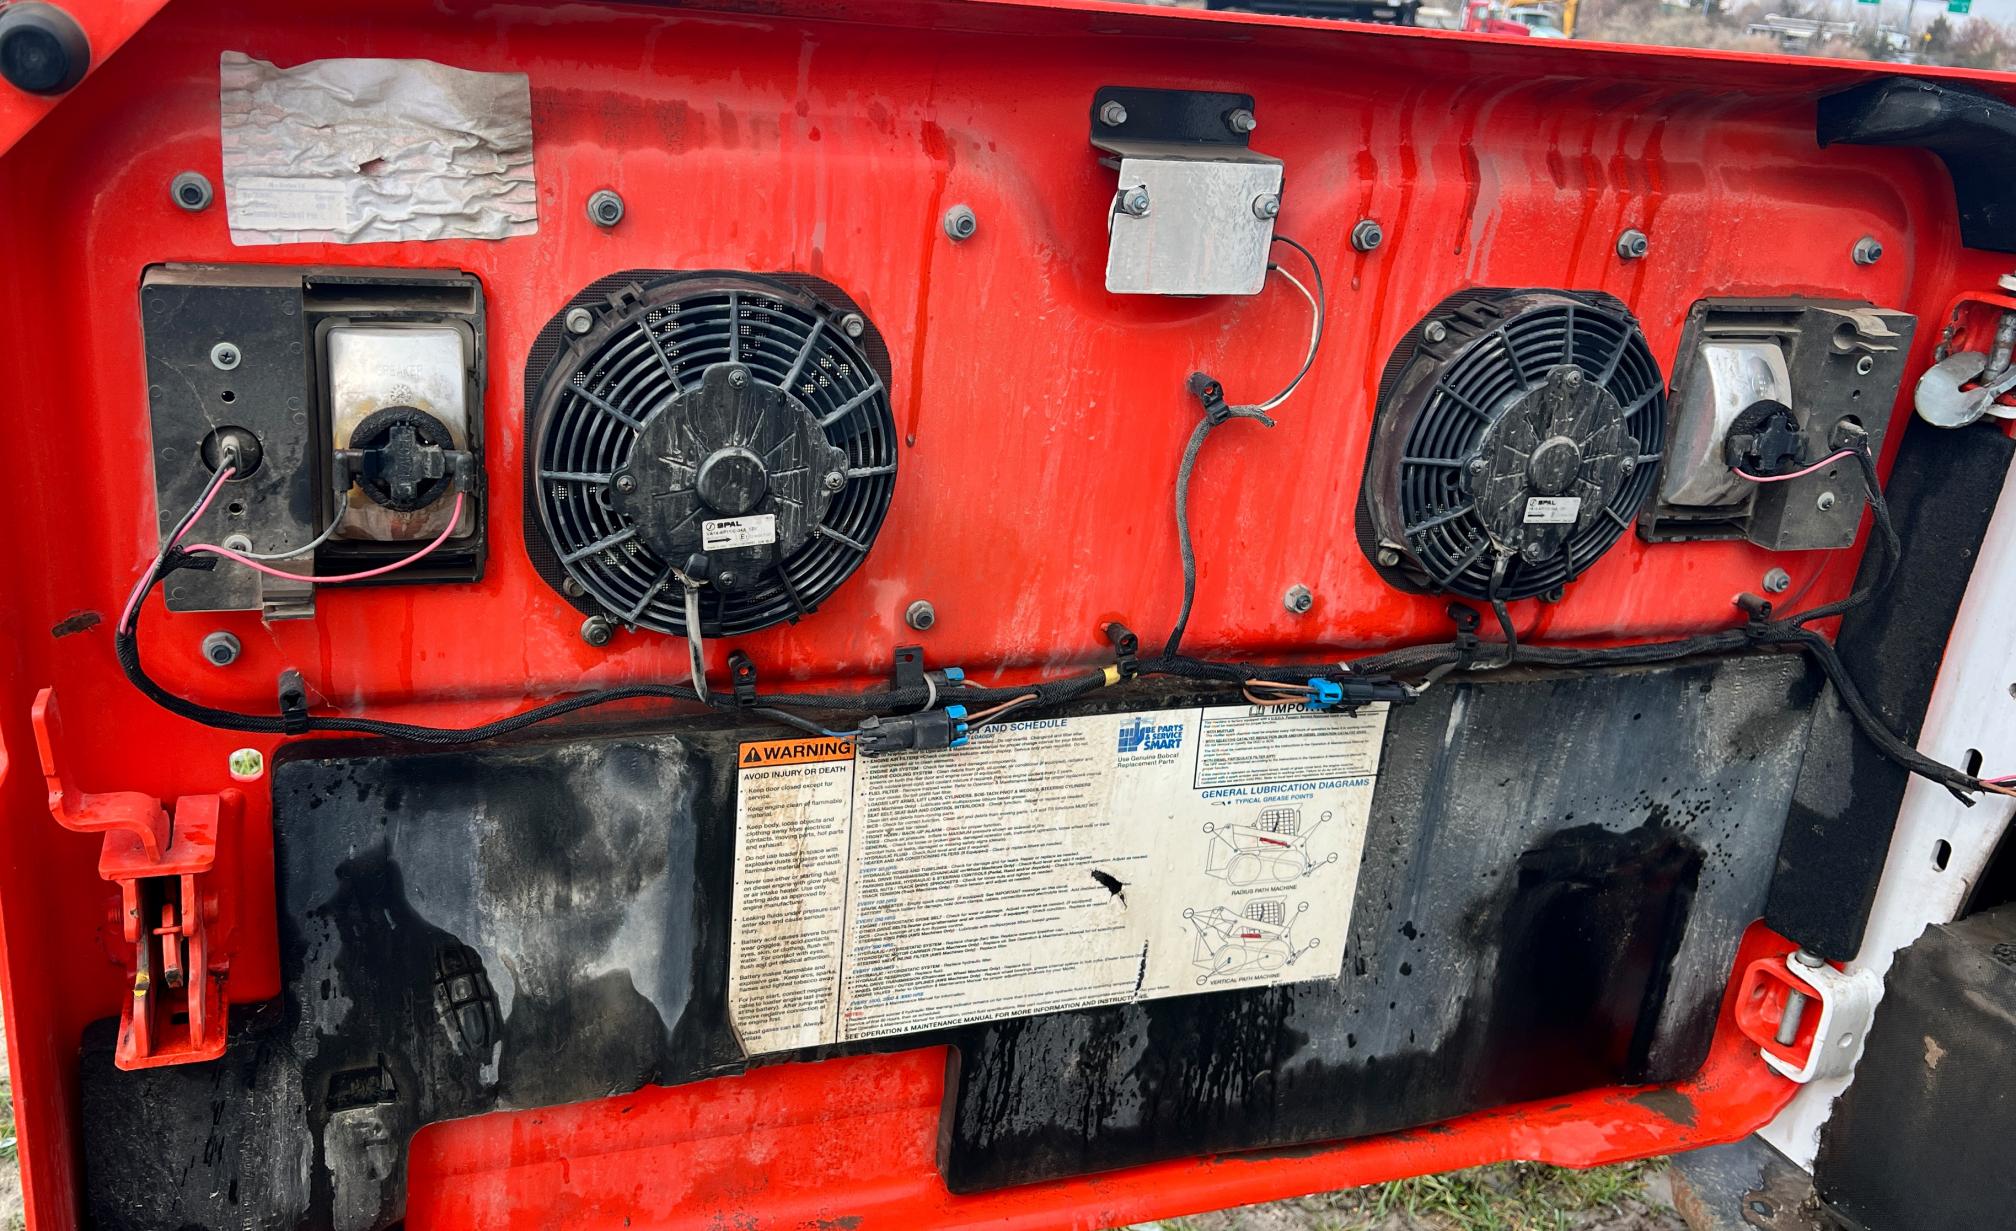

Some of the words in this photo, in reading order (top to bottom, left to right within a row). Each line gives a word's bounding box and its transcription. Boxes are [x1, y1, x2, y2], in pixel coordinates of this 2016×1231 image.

[985, 724, 1007, 733] AND
[1010, 719, 1067, 731] SCHEDULE
[1158, 724, 1183, 732] PARTS
[1152, 731, 1182, 740] SERVICE
[1144, 738, 1182, 750] SMART
[764, 742, 850, 760] WARNING
[1118, 760, 1156, 768] Replacement
[744, 772, 770, 780] AVOID
[771, 769, 802, 778] INJURY
[818, 765, 846, 774] DEATH
[803, 781, 823, 789] except
[1202, 788, 1247, 798] GENERAL
[1251, 782, 1316, 794] LUBRICATION
[1319, 779, 1369, 789] DIAGRAMS
[764, 803, 785, 811] engine
[812, 798, 843, 806] flammable
[1235, 797, 1261, 805] TYPICAL
[799, 818, 821, 826] objects
[804, 823, 831, 831] electrical
[746, 835, 774, 843] contacts,
[798, 831, 816, 839] parts,
[828, 828, 844, 836] parts
[772, 881, 792, 889] engine
[807, 878, 821, 886] glow
[789, 891, 817, 900] approved
[802, 907, 828, 916] pressure
[845, 1032, 859, 1040] SEE
[861, 1027, 902, 1038] OPERATION
[910, 1019, 962, 1031] MAINTENANCE
[963, 1014, 993, 1024] MANUAL
[995, 1011, 1010, 1019] FOR
[1011, 1008, 1032, 1017] MORE
[1033, 1002, 1080, 1014] INFORMATION
[1082, 999, 1096, 1007] AND
